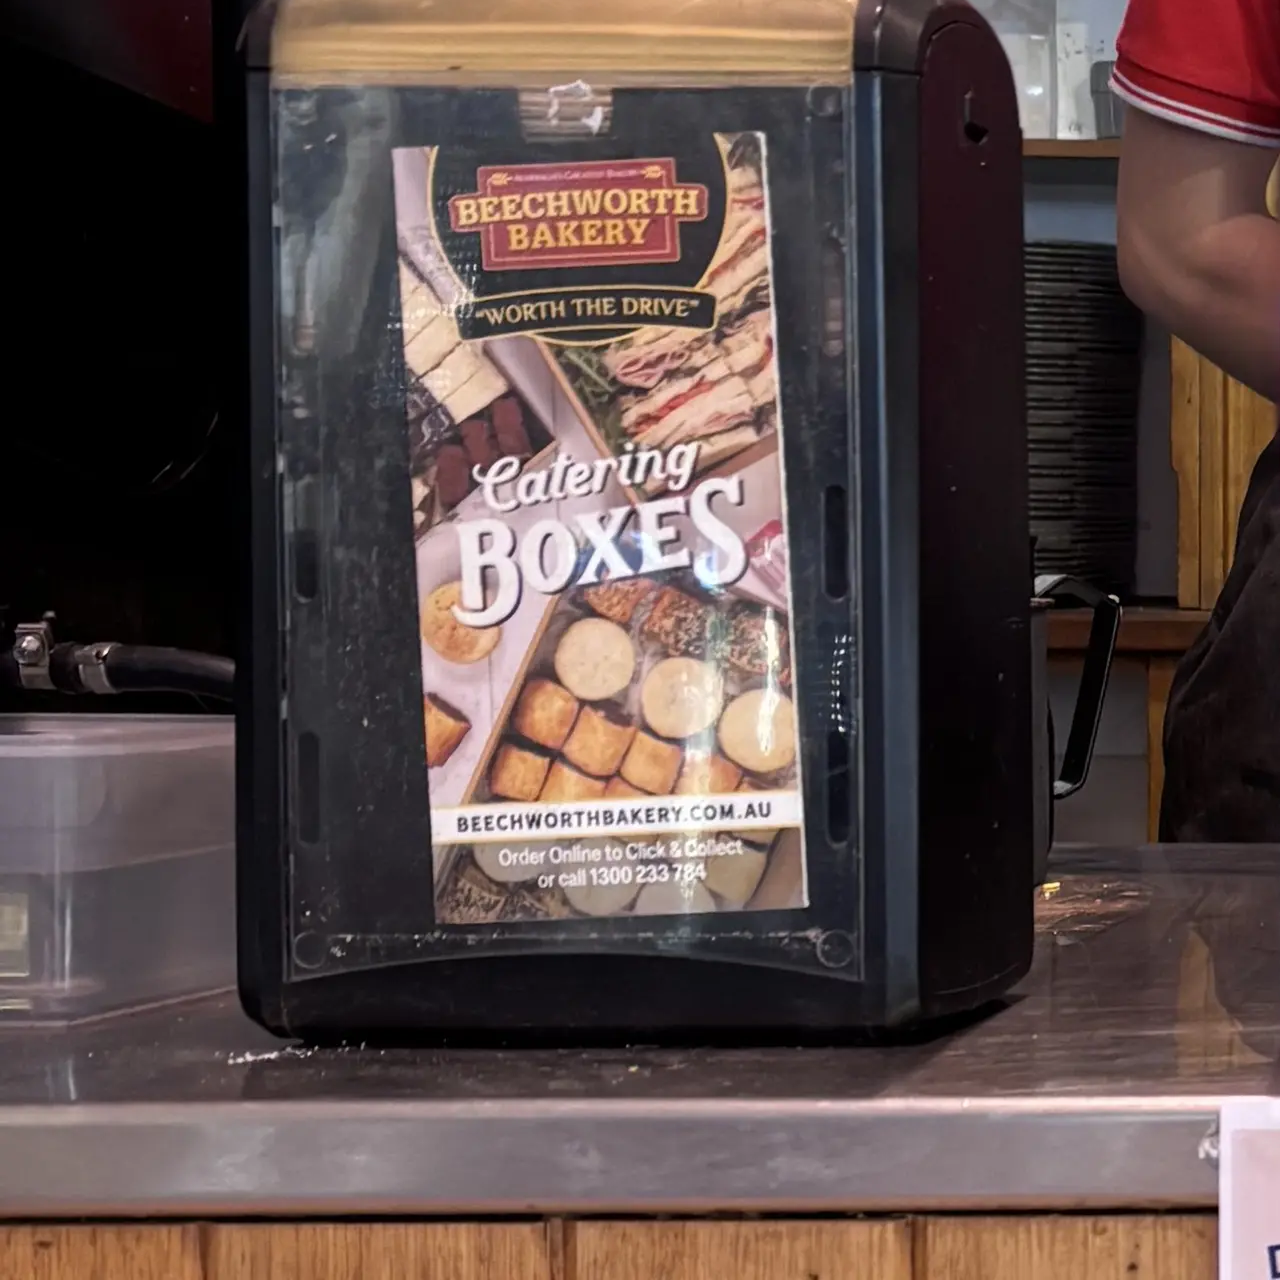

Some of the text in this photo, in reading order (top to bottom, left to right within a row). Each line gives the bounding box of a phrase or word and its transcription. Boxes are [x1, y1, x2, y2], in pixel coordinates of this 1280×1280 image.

[455, 187, 700, 227] BEECHWORTH
[508, 219, 652, 251] BAKERY
[570, 297, 616, 317] THE
[472, 439, 701, 513] Catering
[451, 477, 748, 628] BOXES
[457, 801, 772, 833] BEECHWORTHBAKERY.COM.AU
[499, 838, 743, 868] Order Online to Click & Collect
[538, 861, 707, 889] or call 1300 233 784
